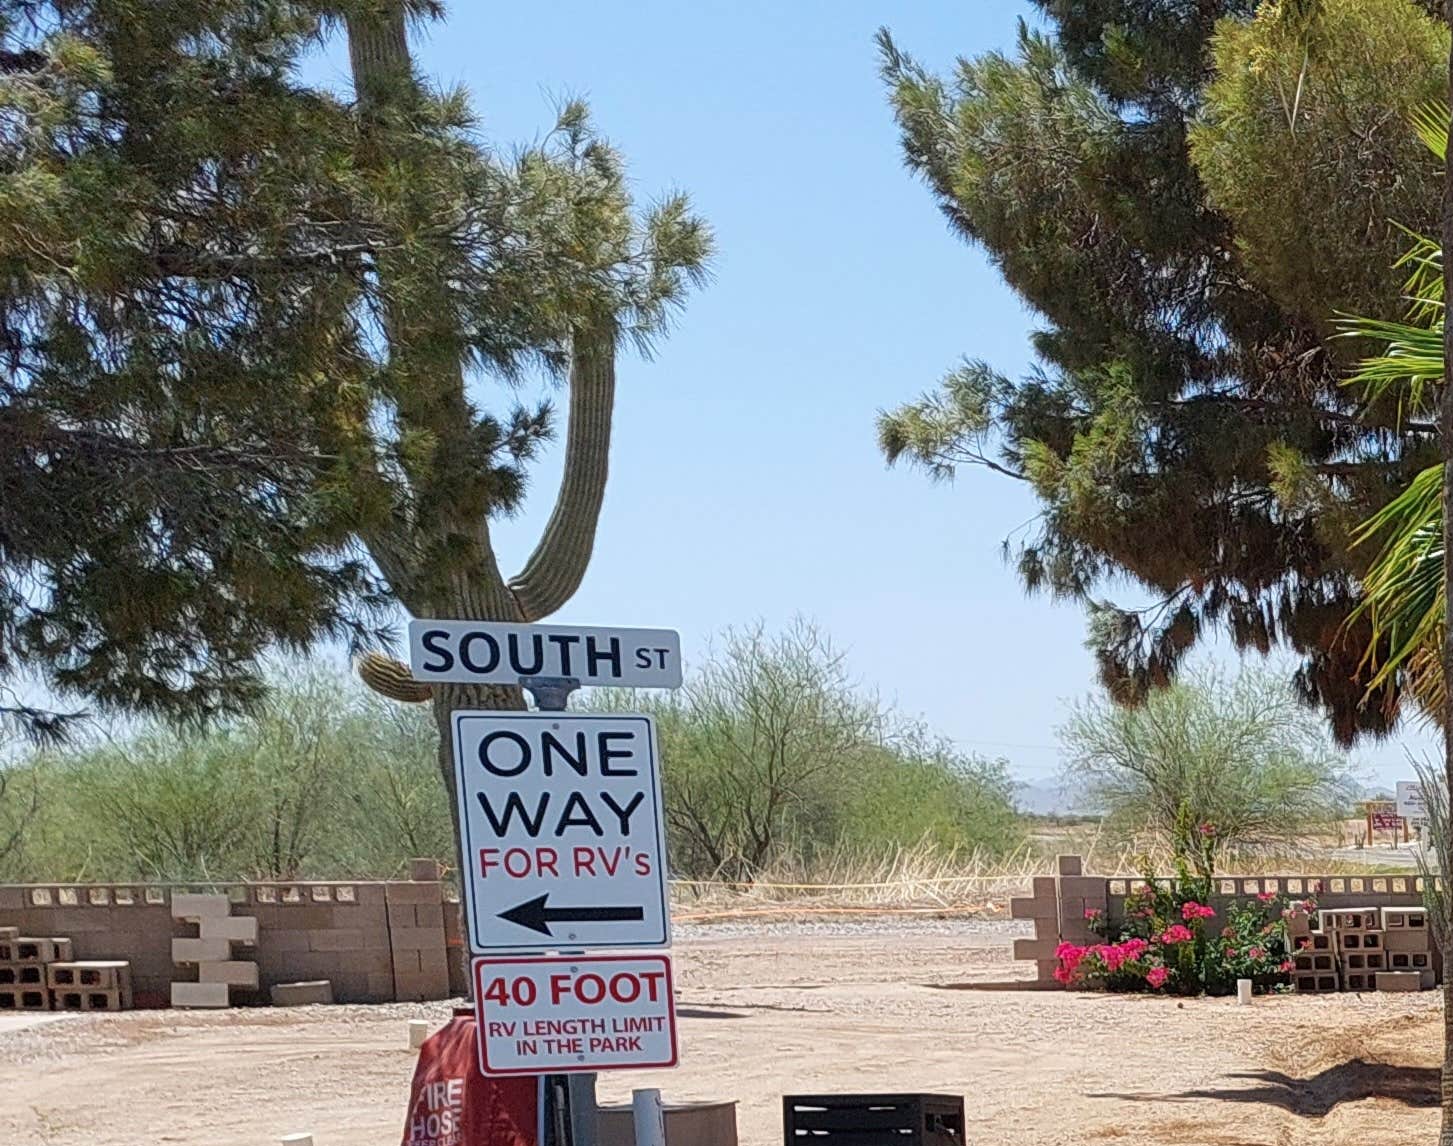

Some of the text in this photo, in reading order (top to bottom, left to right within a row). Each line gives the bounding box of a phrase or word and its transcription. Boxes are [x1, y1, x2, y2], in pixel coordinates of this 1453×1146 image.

[421, 629, 671, 678] SOUTH ST
[477, 729, 639, 778] ONE
[476, 790, 646, 839] WAY
[479, 846, 560, 880] FOR
[483, 970, 666, 1008] 40 FOOT
[488, 1015, 667, 1038] RV LENGTH LIMIT
[516, 1035, 643, 1056] IN THE PARK
